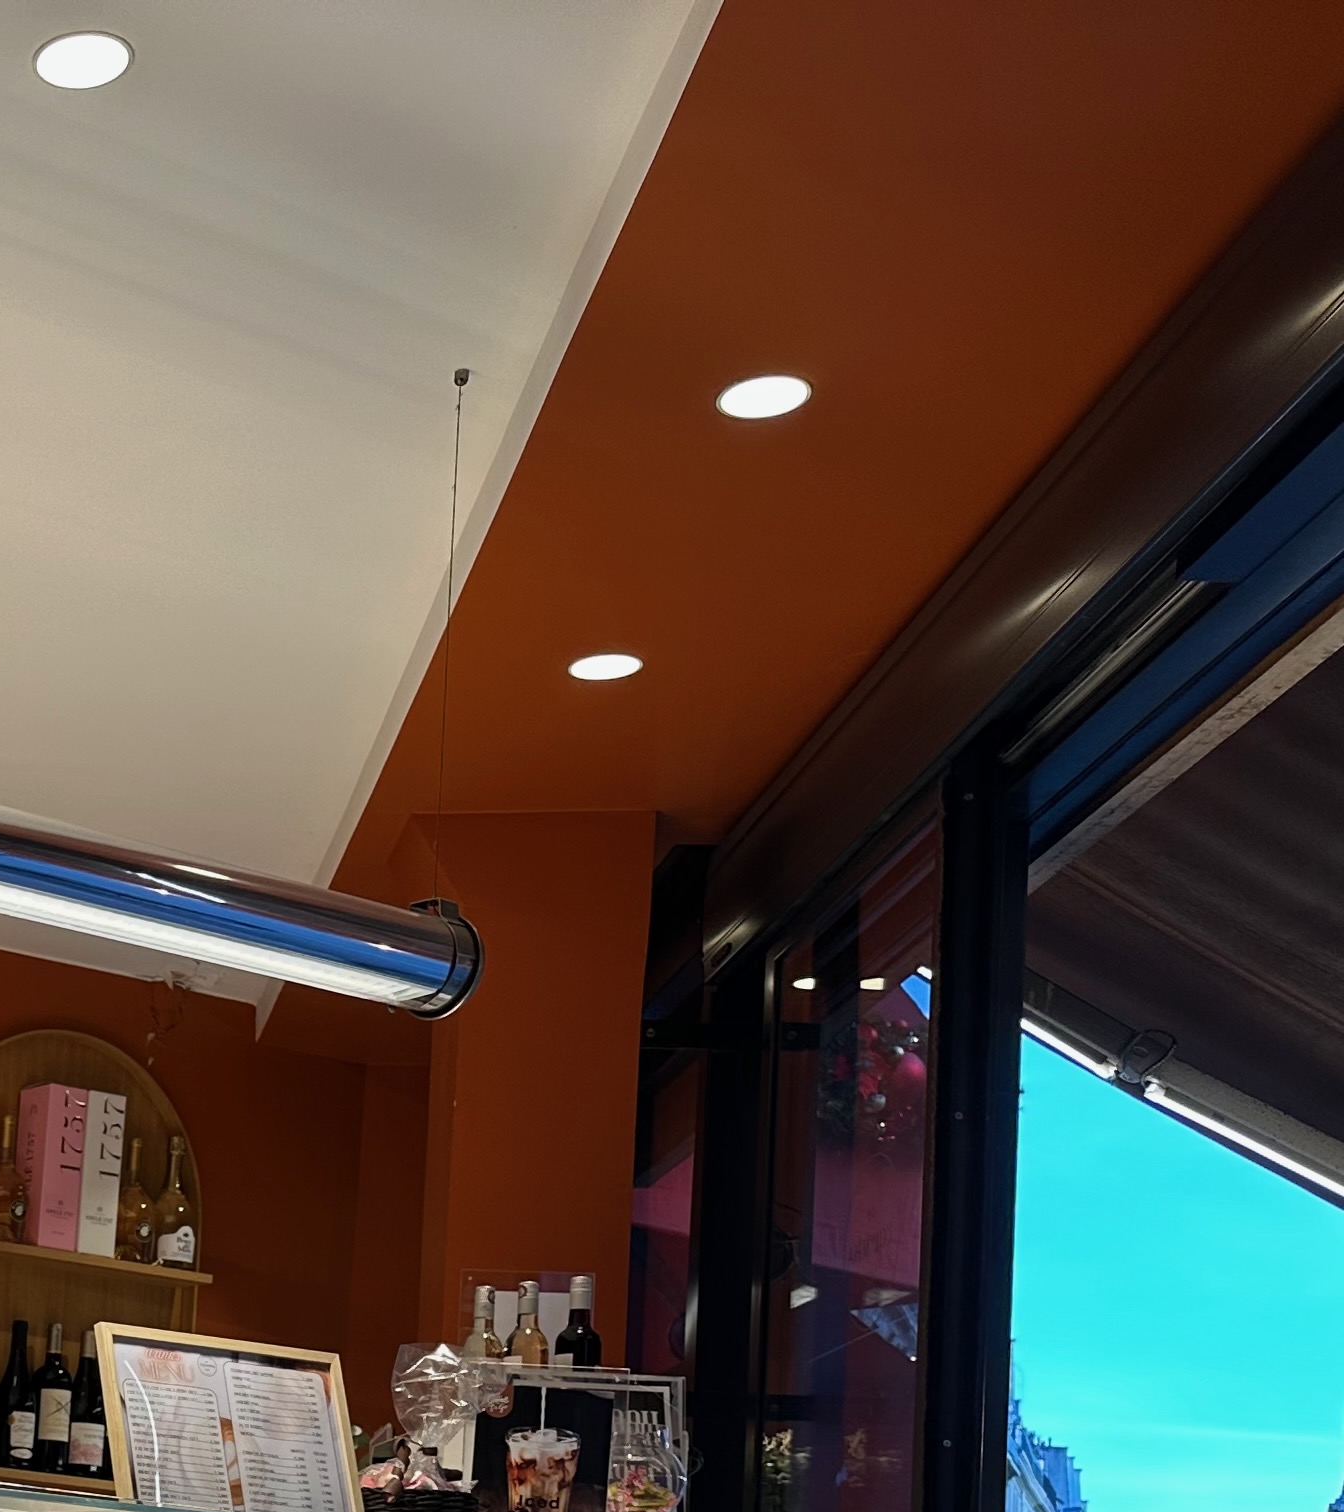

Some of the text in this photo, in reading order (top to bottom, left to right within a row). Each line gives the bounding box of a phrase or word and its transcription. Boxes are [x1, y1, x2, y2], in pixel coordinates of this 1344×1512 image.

[60, 1089, 86, 1173] 1757
[98, 1095, 124, 1179] 1757
[518, 1494, 560, 1510] Iced
